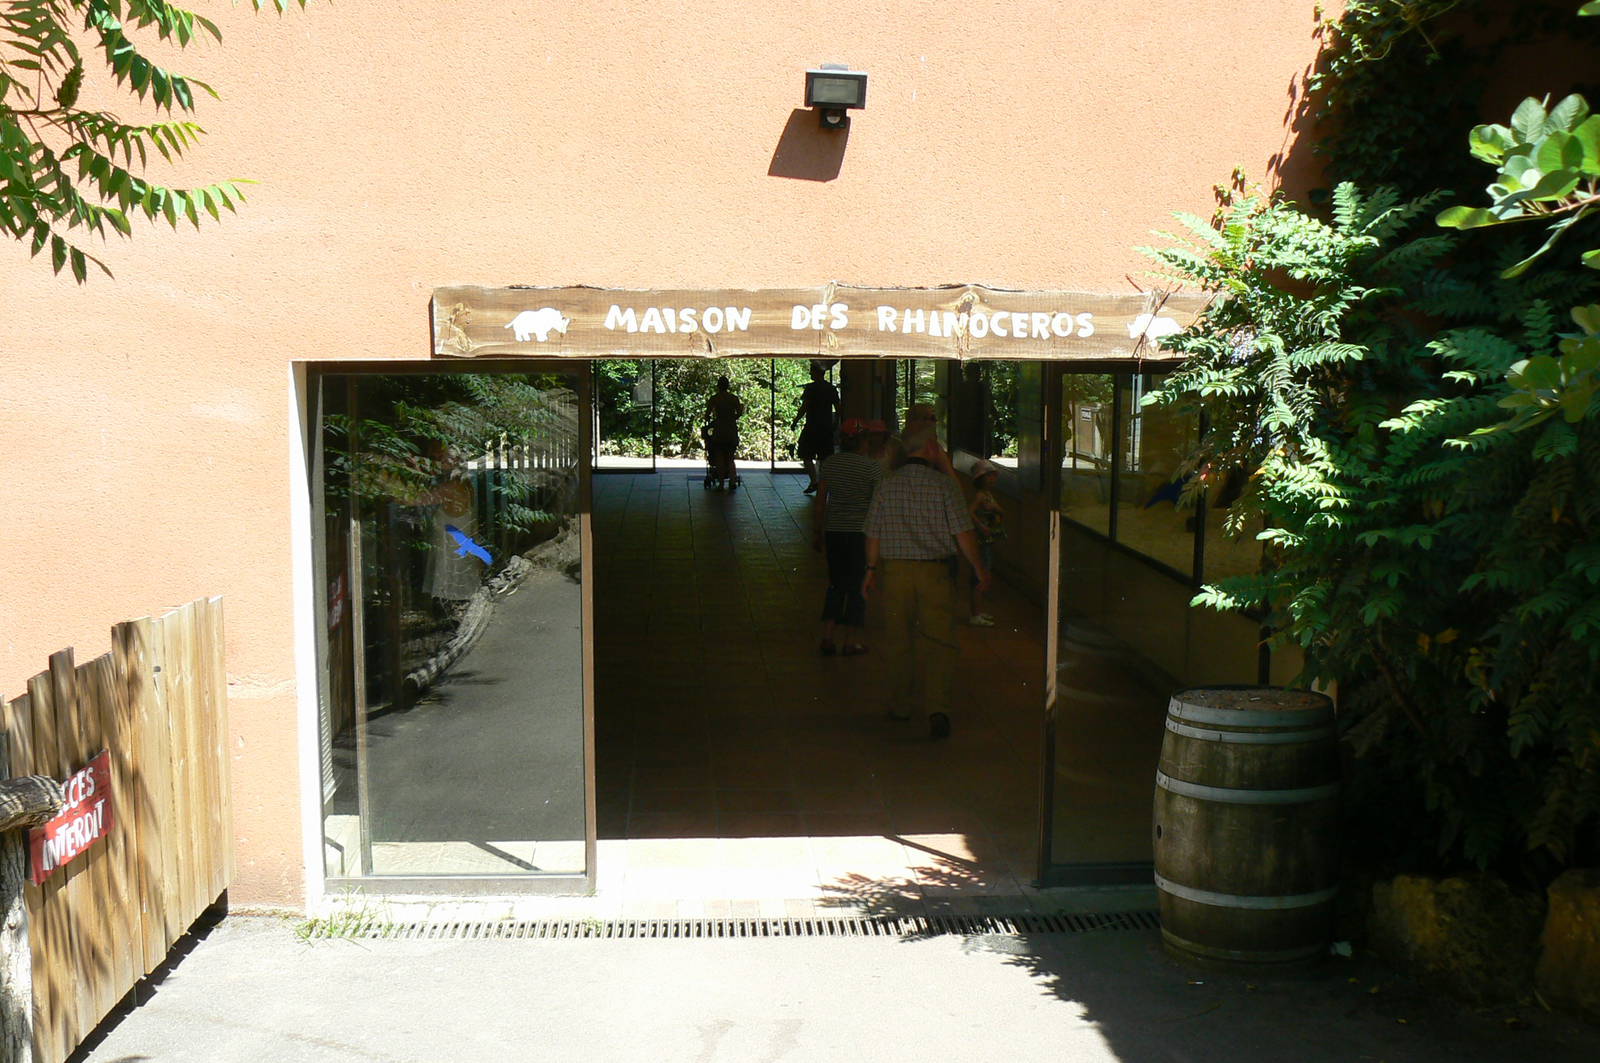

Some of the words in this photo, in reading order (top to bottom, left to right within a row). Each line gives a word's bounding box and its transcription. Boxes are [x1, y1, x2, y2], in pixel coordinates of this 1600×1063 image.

[603, 304, 753, 335] MAISON
[790, 302, 850, 331] DES
[876, 305, 1096, 341] RHINOCEROS
[42, 798, 106, 872] INTERDIT
